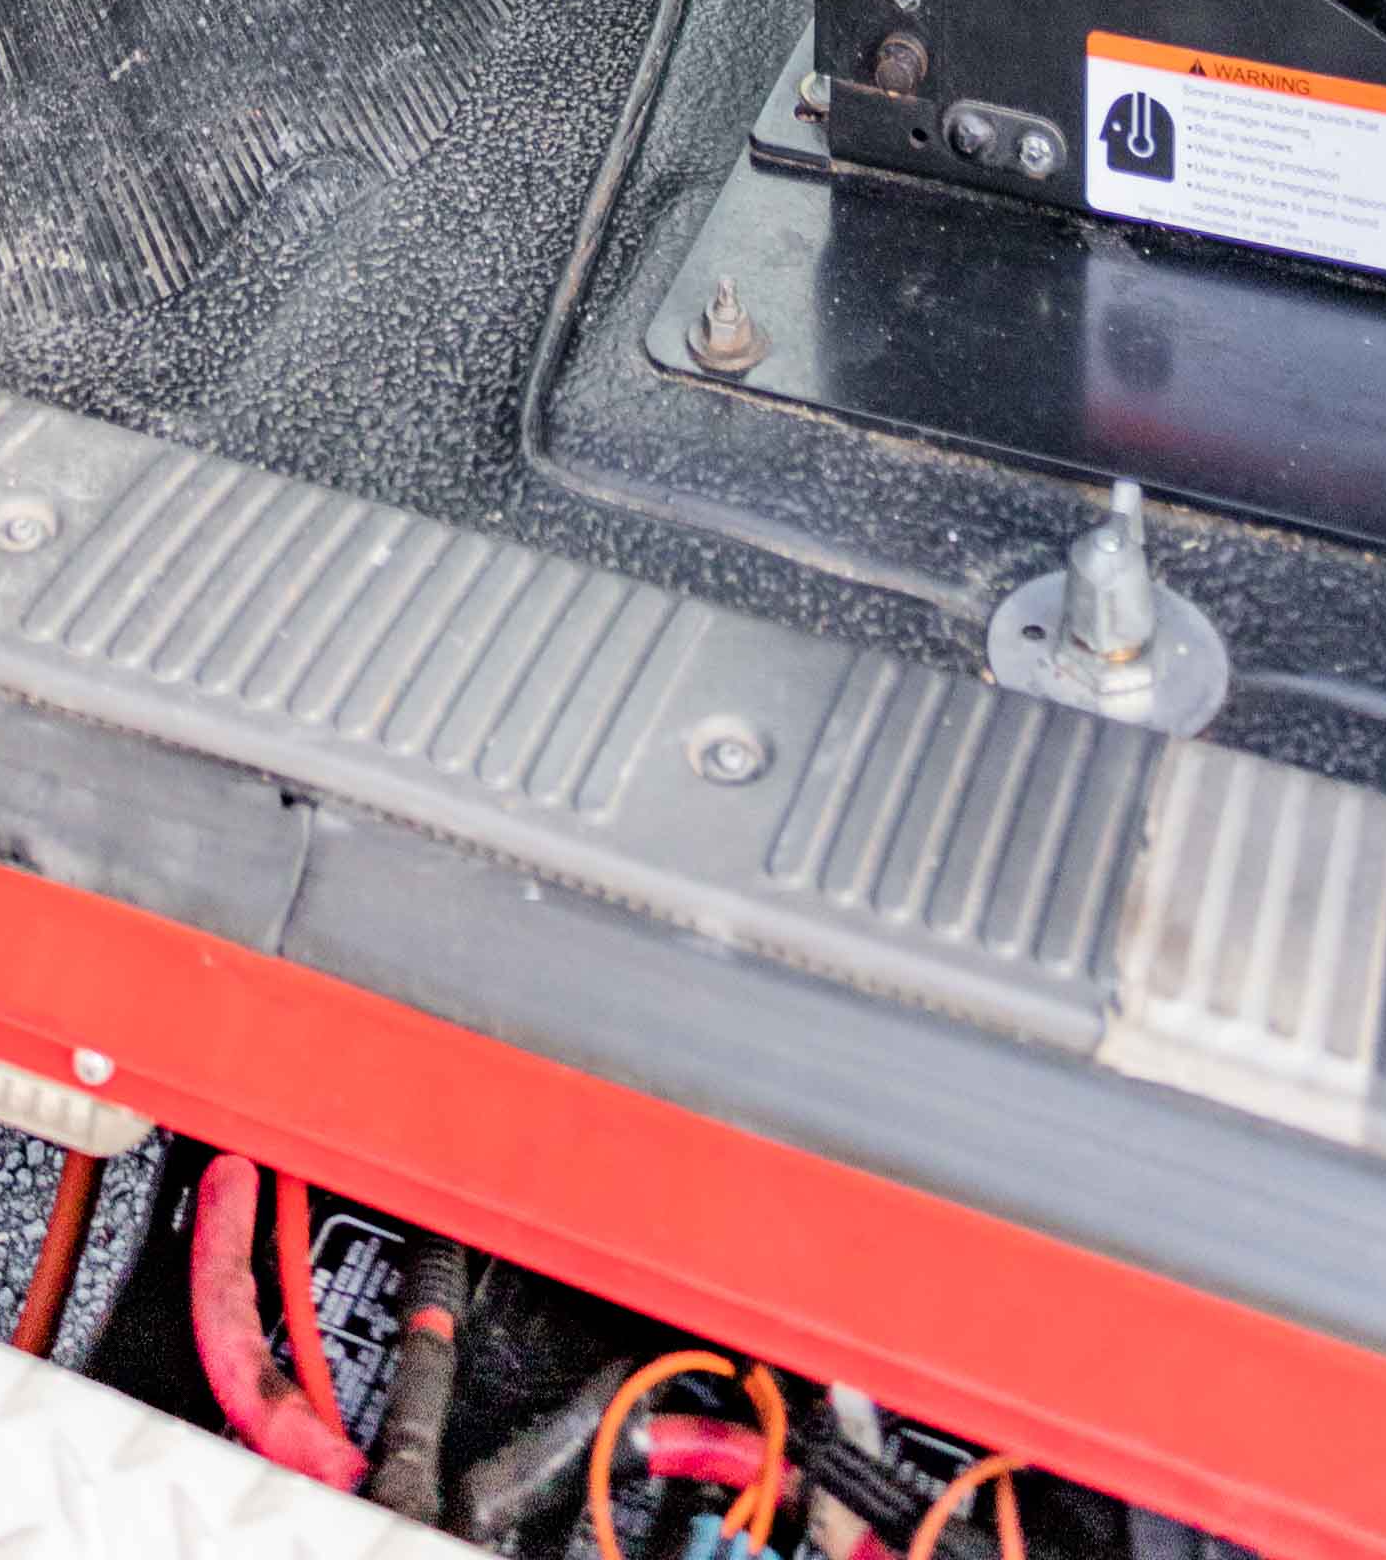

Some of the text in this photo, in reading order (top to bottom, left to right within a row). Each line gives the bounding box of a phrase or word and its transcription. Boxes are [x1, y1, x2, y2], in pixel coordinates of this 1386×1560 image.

[1214, 64, 1311, 96] WARNING
[1182, 104, 1207, 120] may
[1211, 110, 1261, 130] damage
[1224, 94, 1274, 114] produce
[1277, 103, 1304, 118] loud
[1307, 110, 1352, 128] sounds
[1355, 118, 1380, 133] that
[1194, 142, 1226, 159] Wear
[1230, 150, 1276, 171] hearing
[1194, 161, 1218, 178] Use
[1221, 167, 1247, 184] only
[1250, 173, 1267, 187] for
[1270, 178, 1340, 203] emergency
[1231, 190, 1287, 210] exposure
